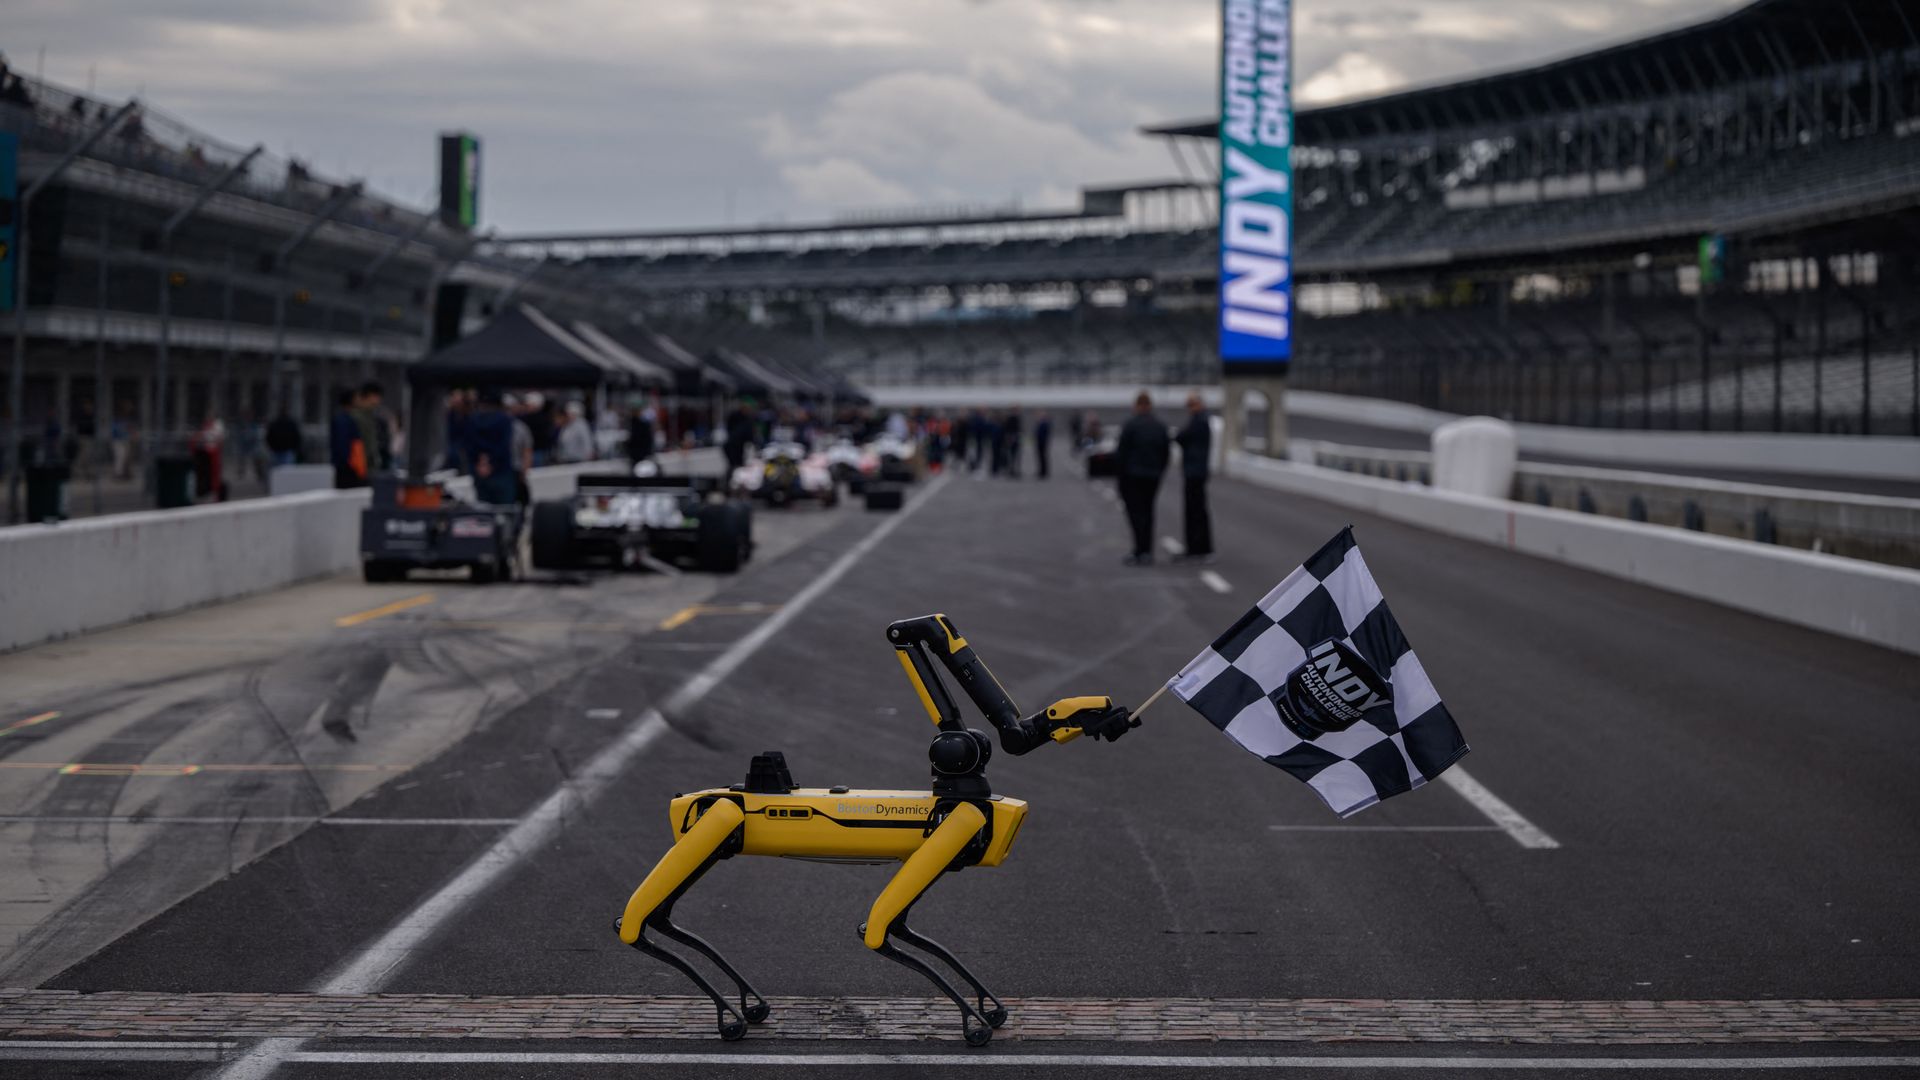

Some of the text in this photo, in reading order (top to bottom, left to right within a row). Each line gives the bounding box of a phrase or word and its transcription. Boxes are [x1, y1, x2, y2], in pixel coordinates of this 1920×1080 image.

[1224, 0, 1256, 147] AUTONO
[1222, 147, 1289, 341] INDY
[1301, 673, 1352, 721] CHALLENGE
[1305, 664, 1363, 718] AUTONOMOUS
[1310, 640, 1392, 712] INDY
